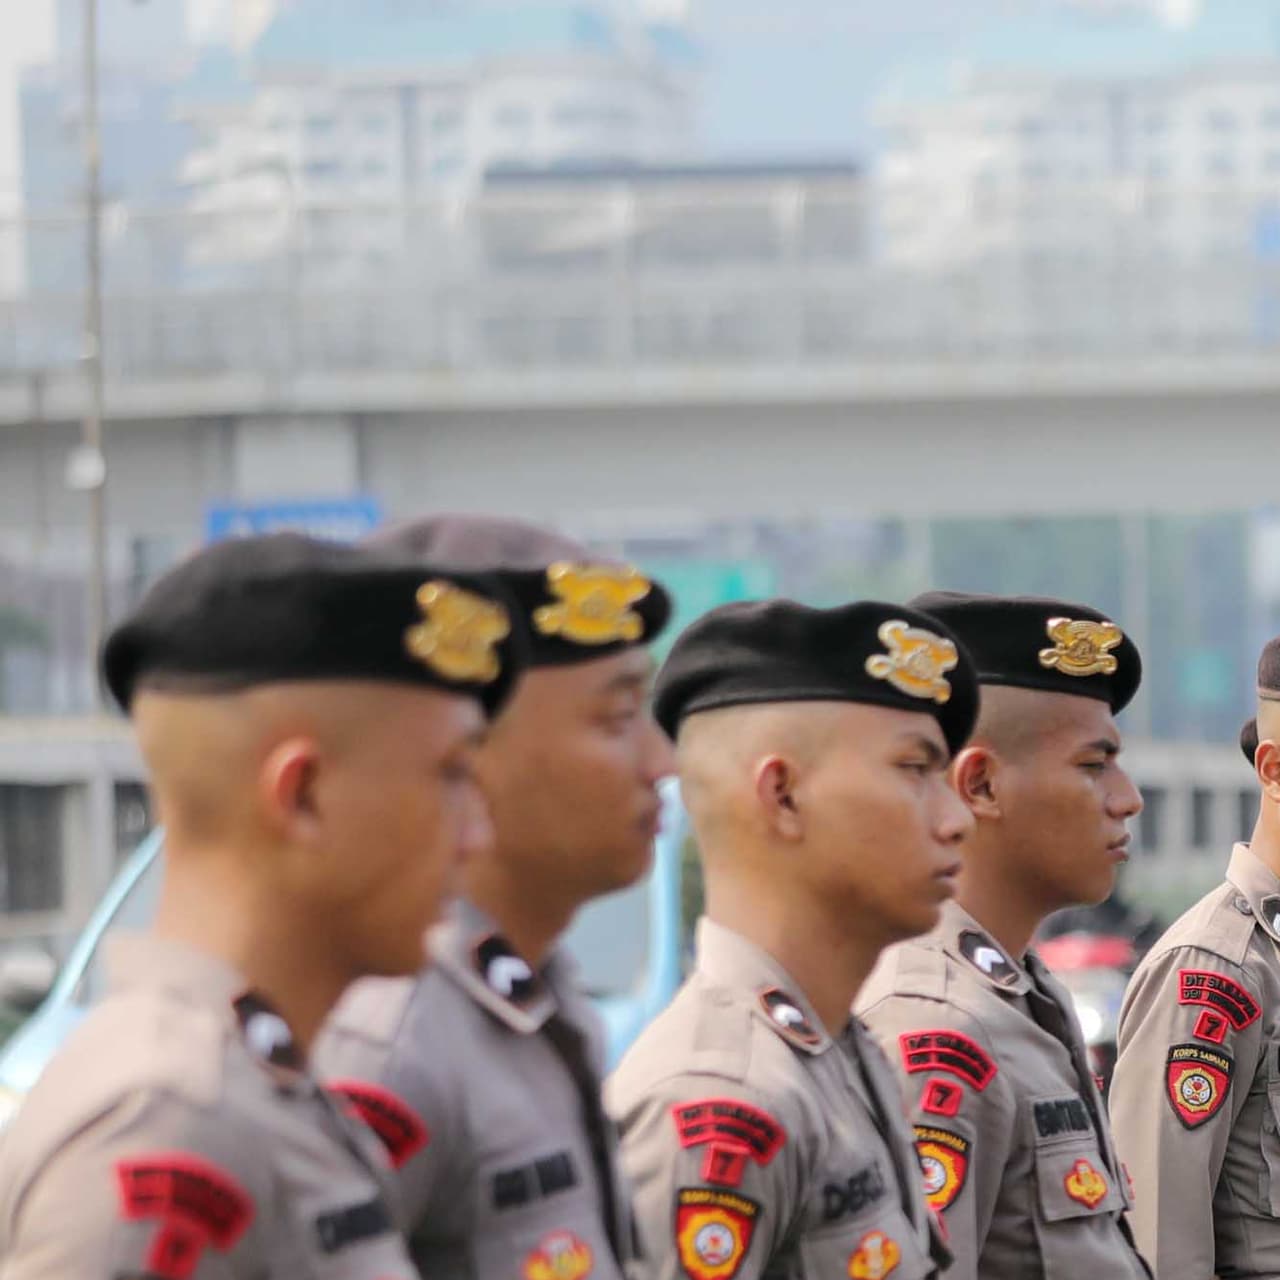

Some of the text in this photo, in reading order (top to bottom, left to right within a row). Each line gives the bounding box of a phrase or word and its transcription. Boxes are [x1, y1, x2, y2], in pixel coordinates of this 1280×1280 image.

[1205, 1017, 1220, 1036] 7
[1173, 1048, 1198, 1059] KORPS
[936, 1084, 953, 1108] 7
